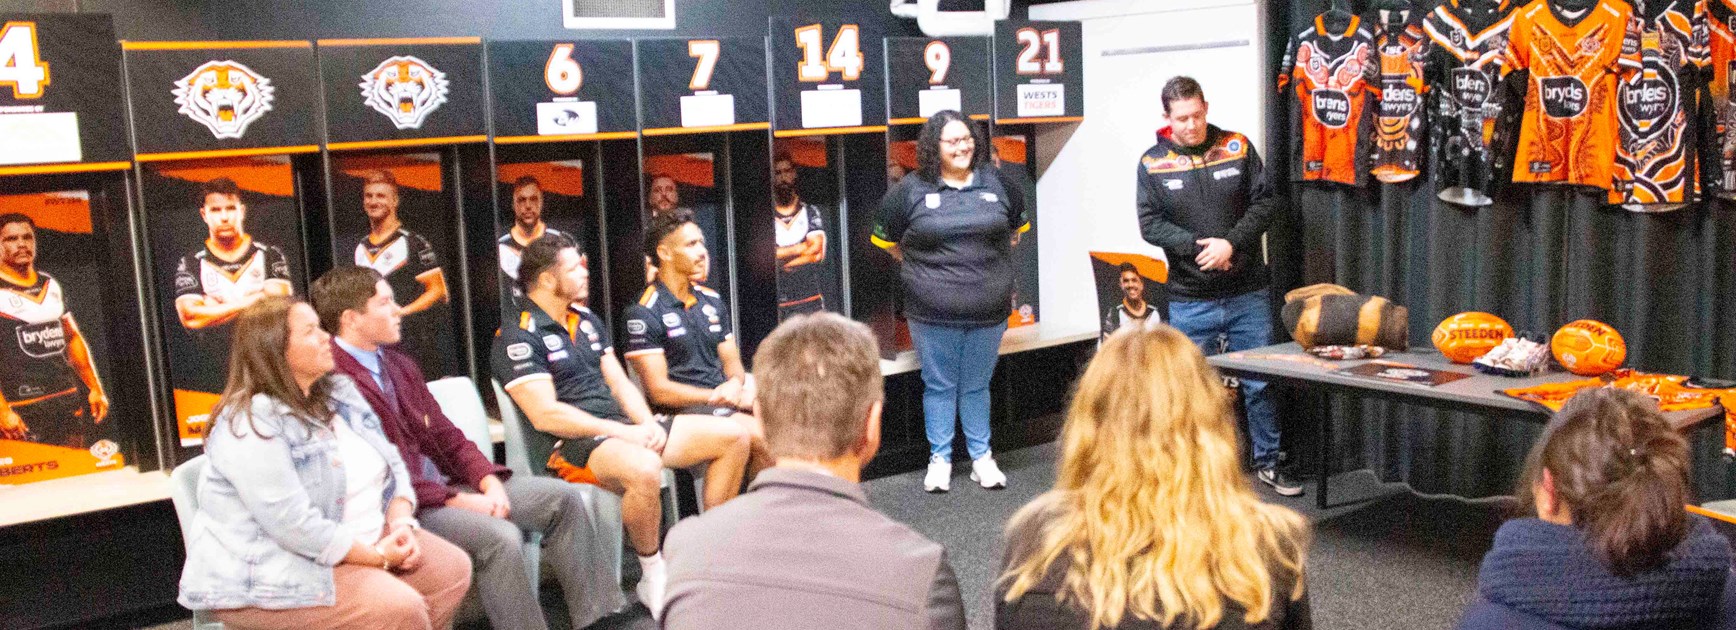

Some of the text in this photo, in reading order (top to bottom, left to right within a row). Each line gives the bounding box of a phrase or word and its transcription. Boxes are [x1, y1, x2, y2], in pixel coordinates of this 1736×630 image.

[544, 43, 583, 95] 6
[688, 40, 720, 90] 7
[794, 23, 864, 82] 14
[923, 40, 951, 84] 9
[1015, 26, 1065, 75] 21
[1023, 91, 1058, 100] WESTS
[1024, 101, 1057, 110] TIGERS
[1450, 328, 1504, 341] STEEDEN
